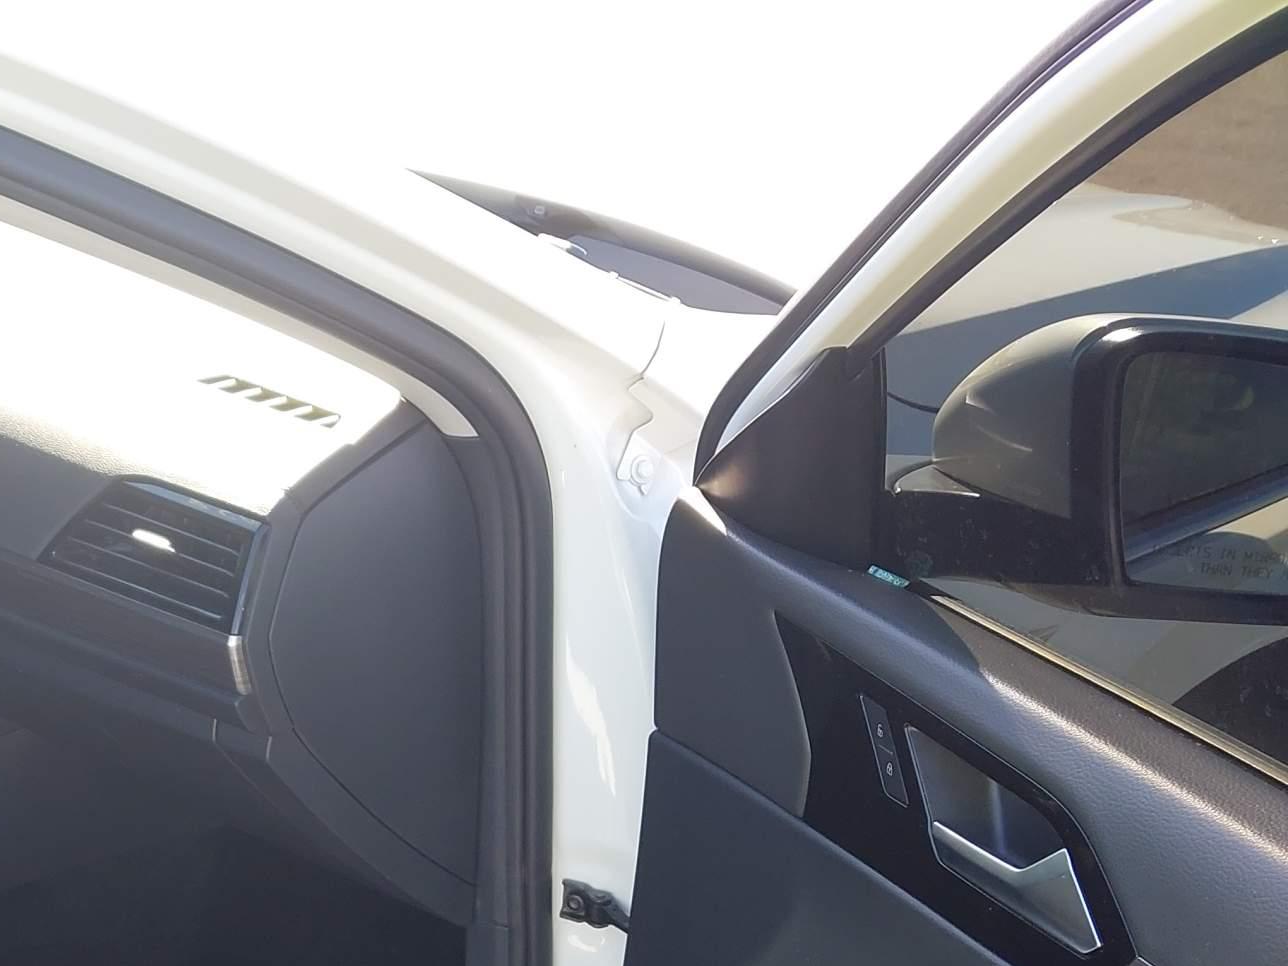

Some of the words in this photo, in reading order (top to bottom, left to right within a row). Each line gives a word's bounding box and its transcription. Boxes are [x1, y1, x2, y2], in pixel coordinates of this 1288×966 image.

[1220, 547, 1237, 560] IN
[1200, 562, 1233, 576] THAN
[1241, 565, 1273, 579] THEY
